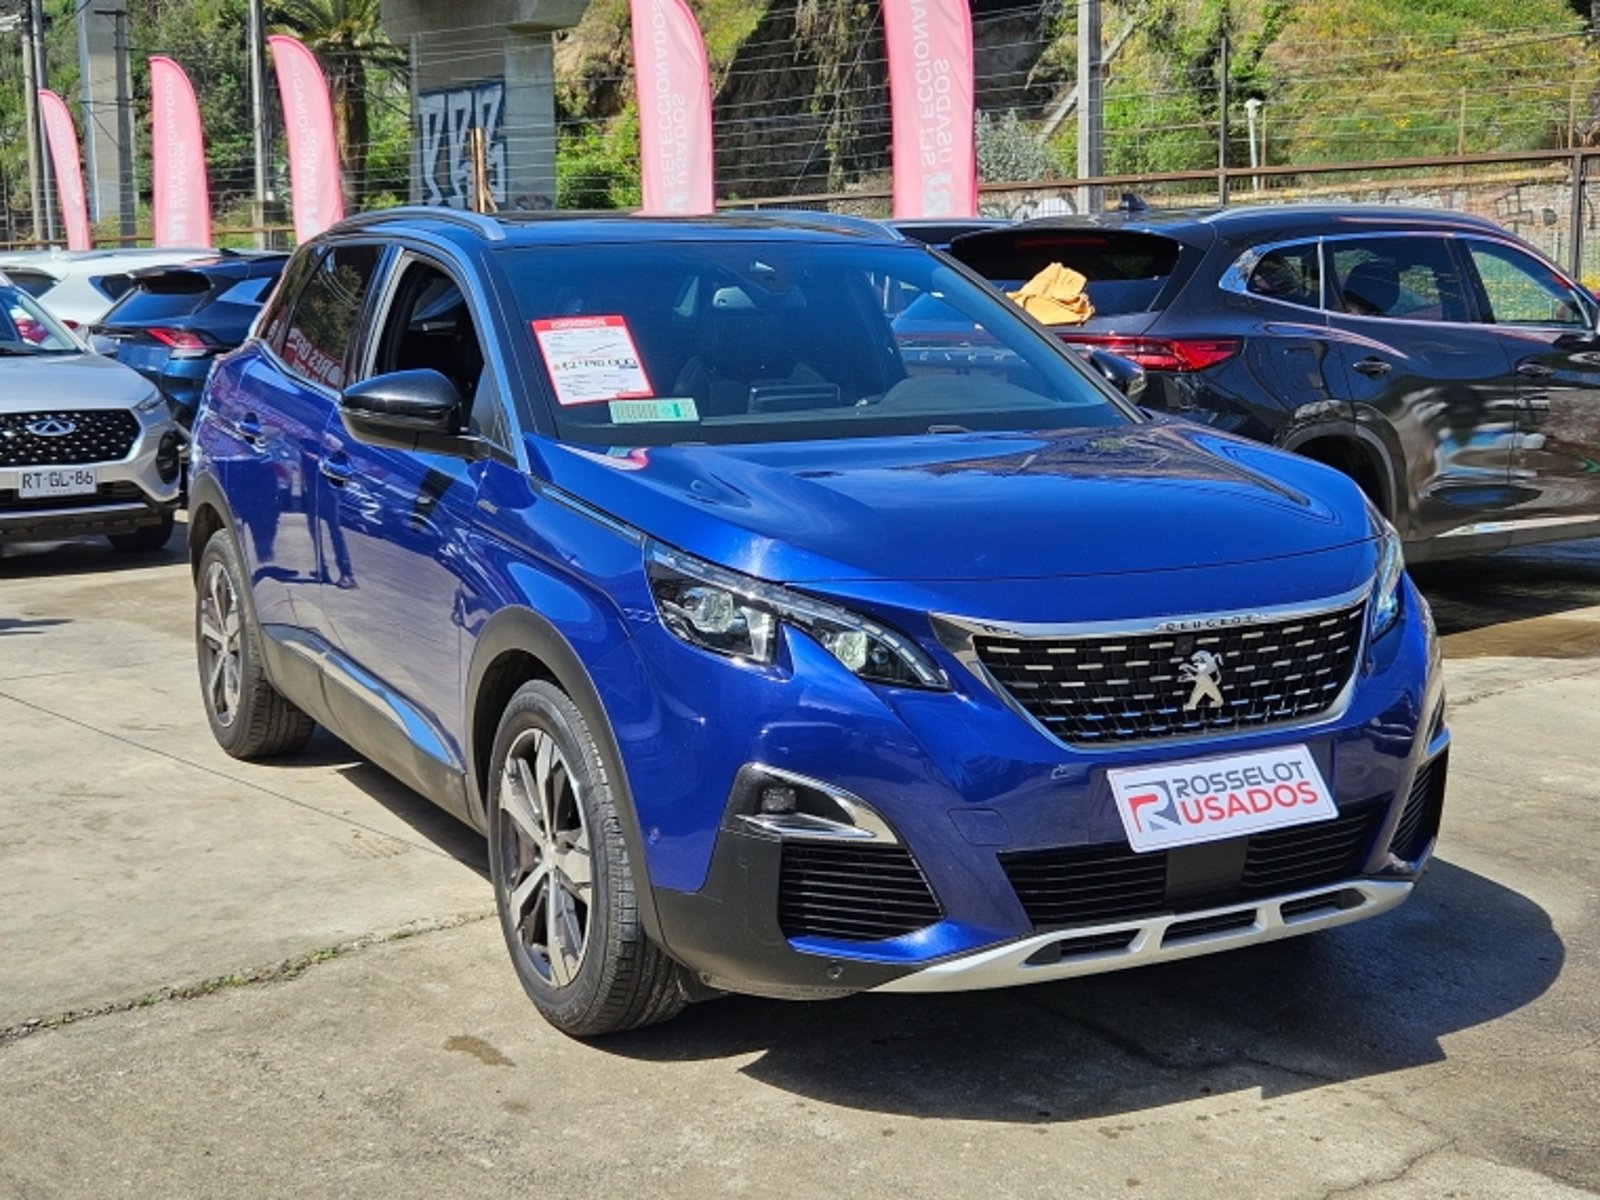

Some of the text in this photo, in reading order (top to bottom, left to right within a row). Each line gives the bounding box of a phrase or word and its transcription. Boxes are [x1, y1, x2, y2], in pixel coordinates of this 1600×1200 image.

[1165, 614, 1254, 632] PEUGEOT
[1172, 761, 1307, 799] ROSSELOT
[1180, 781, 1319, 824] USADOS
